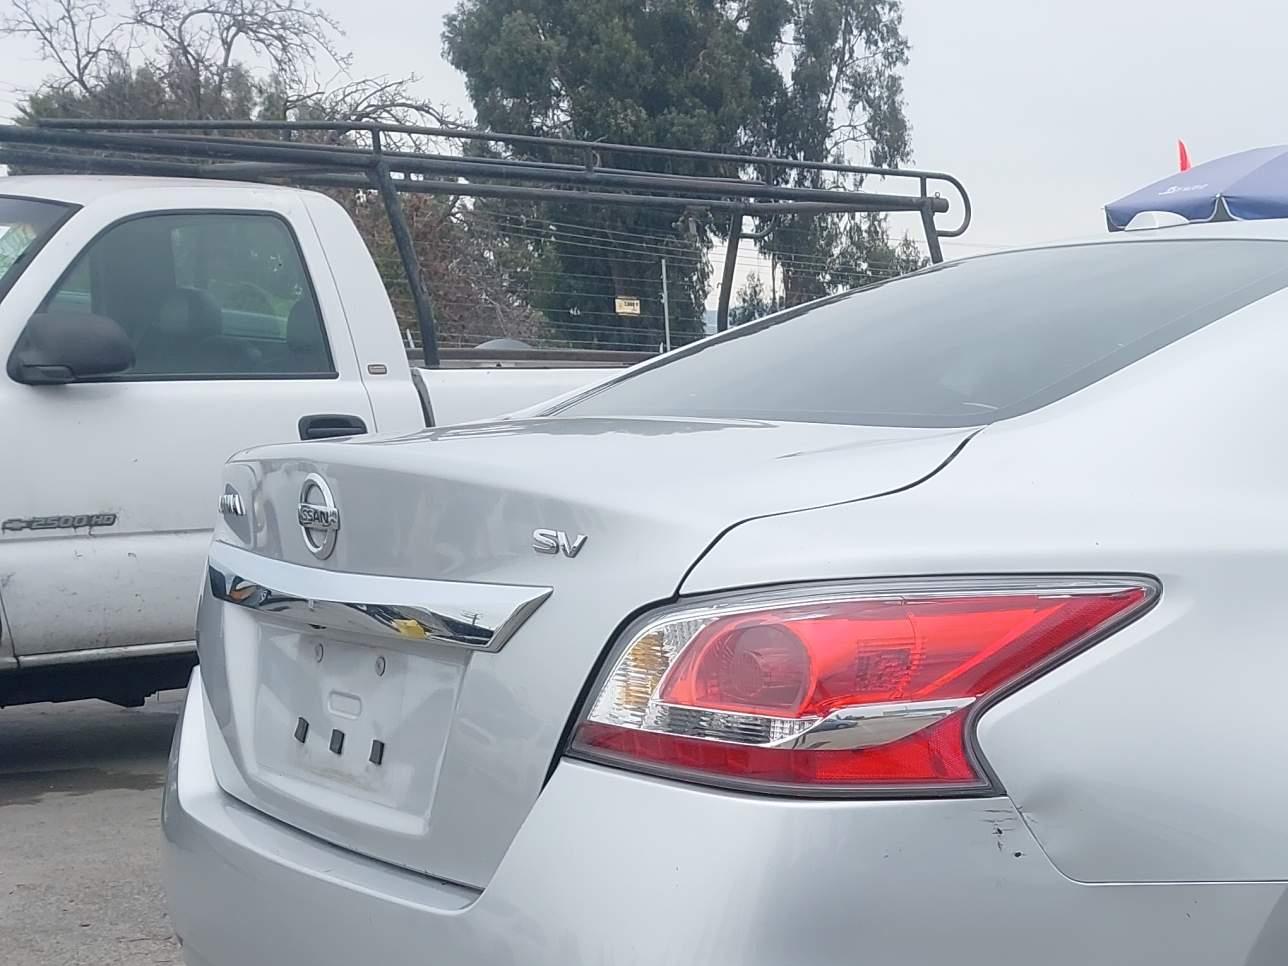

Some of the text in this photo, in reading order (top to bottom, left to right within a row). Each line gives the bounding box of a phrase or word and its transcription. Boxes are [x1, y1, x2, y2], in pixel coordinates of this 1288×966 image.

[31, 515, 115, 530] 2500 HD
[533, 529, 588, 558] SV
